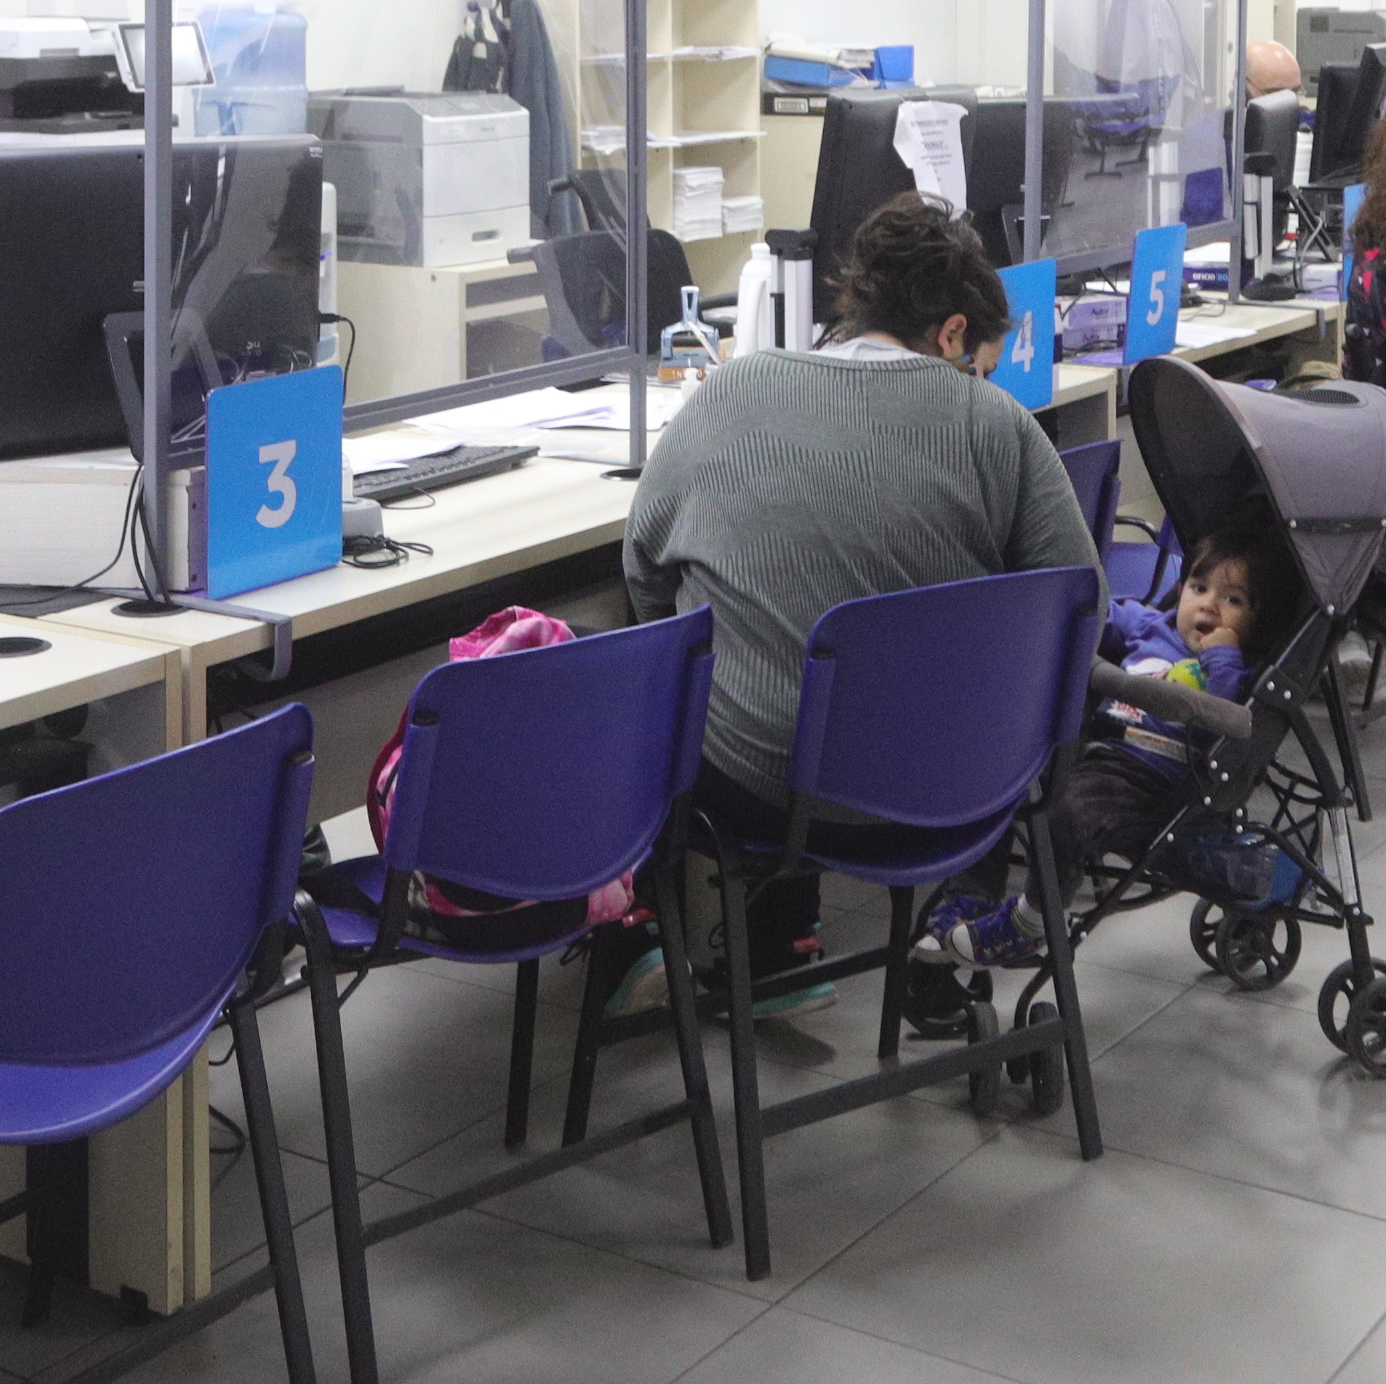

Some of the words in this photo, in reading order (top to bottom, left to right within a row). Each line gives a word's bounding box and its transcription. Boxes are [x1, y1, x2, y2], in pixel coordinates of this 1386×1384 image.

[1091, 307, 1110, 316] Autor
[1147, 270, 1166, 326] 5
[1011, 310, 1035, 373] 4
[255, 439, 297, 529] 3
